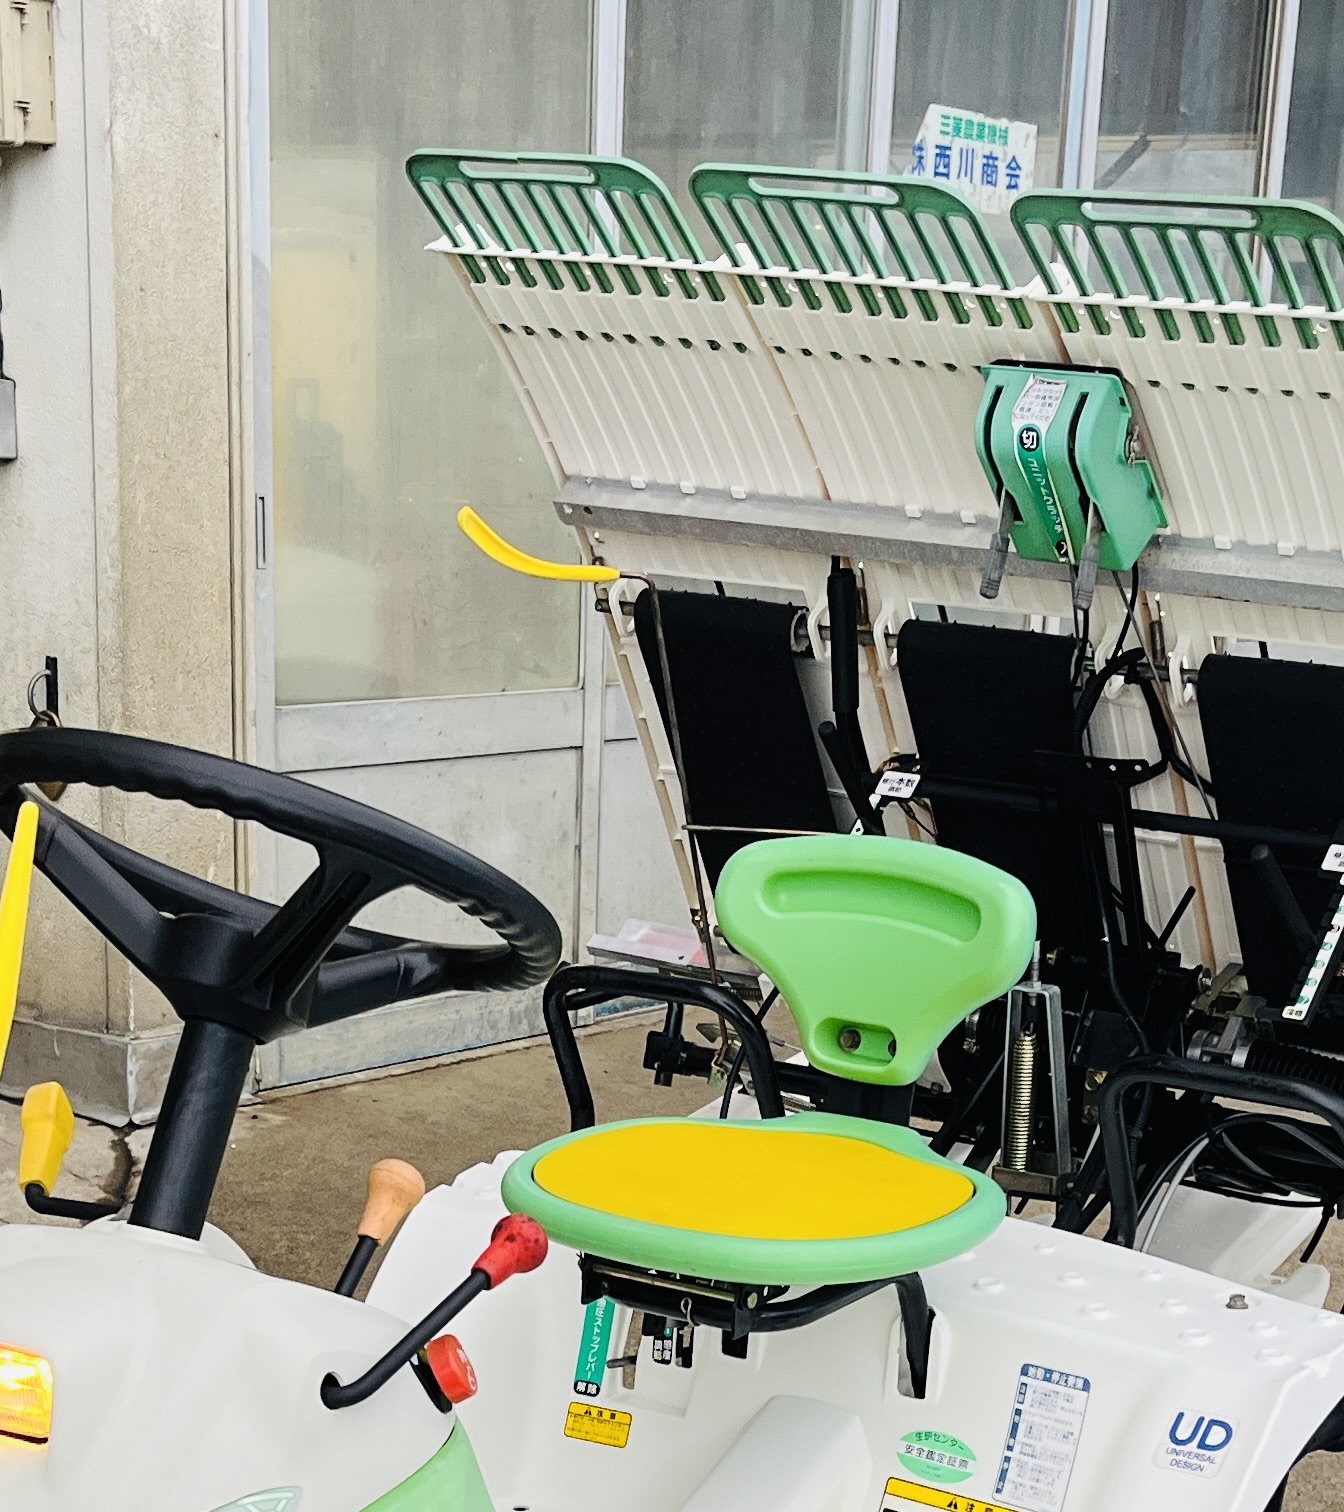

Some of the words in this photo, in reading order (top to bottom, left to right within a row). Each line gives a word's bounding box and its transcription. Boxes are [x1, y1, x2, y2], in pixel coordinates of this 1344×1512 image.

[1022, 429, 1037, 450] 切
[1169, 1411, 1233, 1452] UD
[1165, 1446, 1216, 1465] UNIVERSAL
[1169, 1458, 1205, 1473] DESIGN
